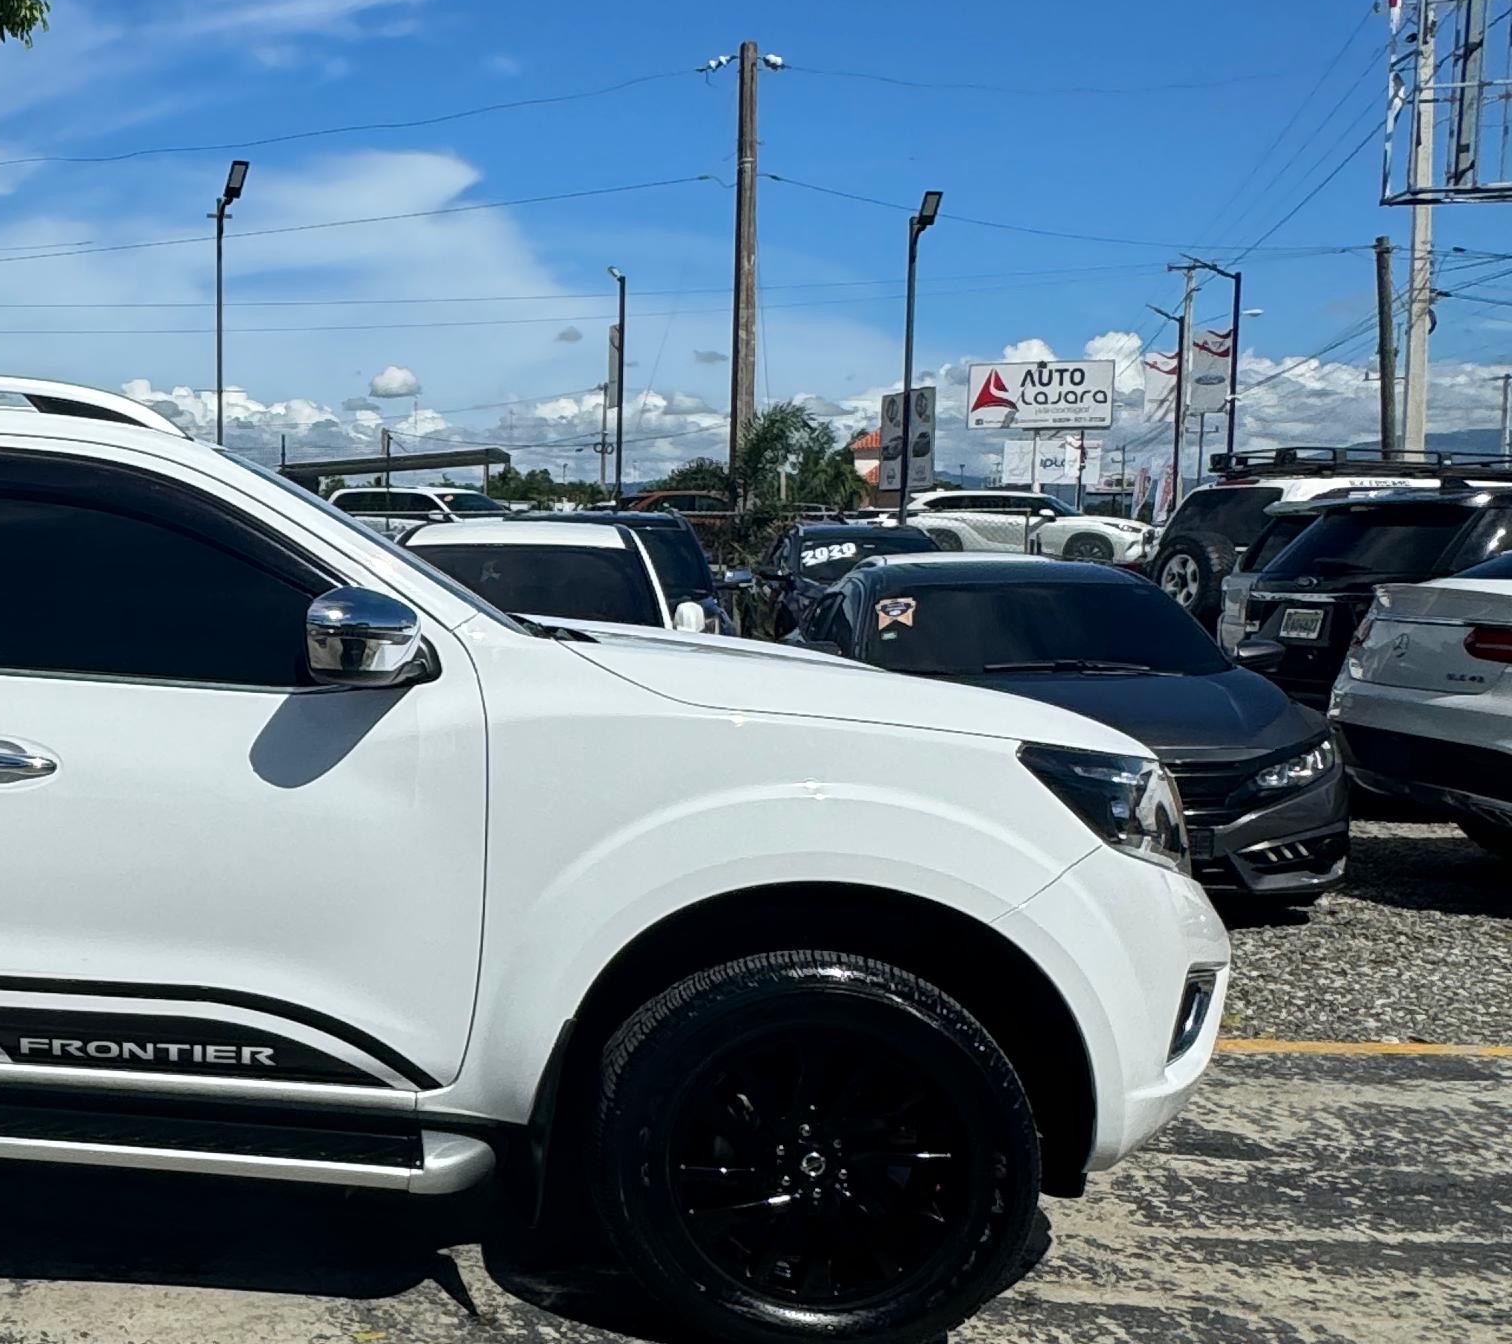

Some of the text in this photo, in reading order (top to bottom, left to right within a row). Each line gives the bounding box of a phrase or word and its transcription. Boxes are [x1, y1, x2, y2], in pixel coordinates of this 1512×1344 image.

[1020, 367, 1085, 387] AUTO
[800, 542, 857, 567] 2020
[19, 1037, 277, 1066] FRONTIER
